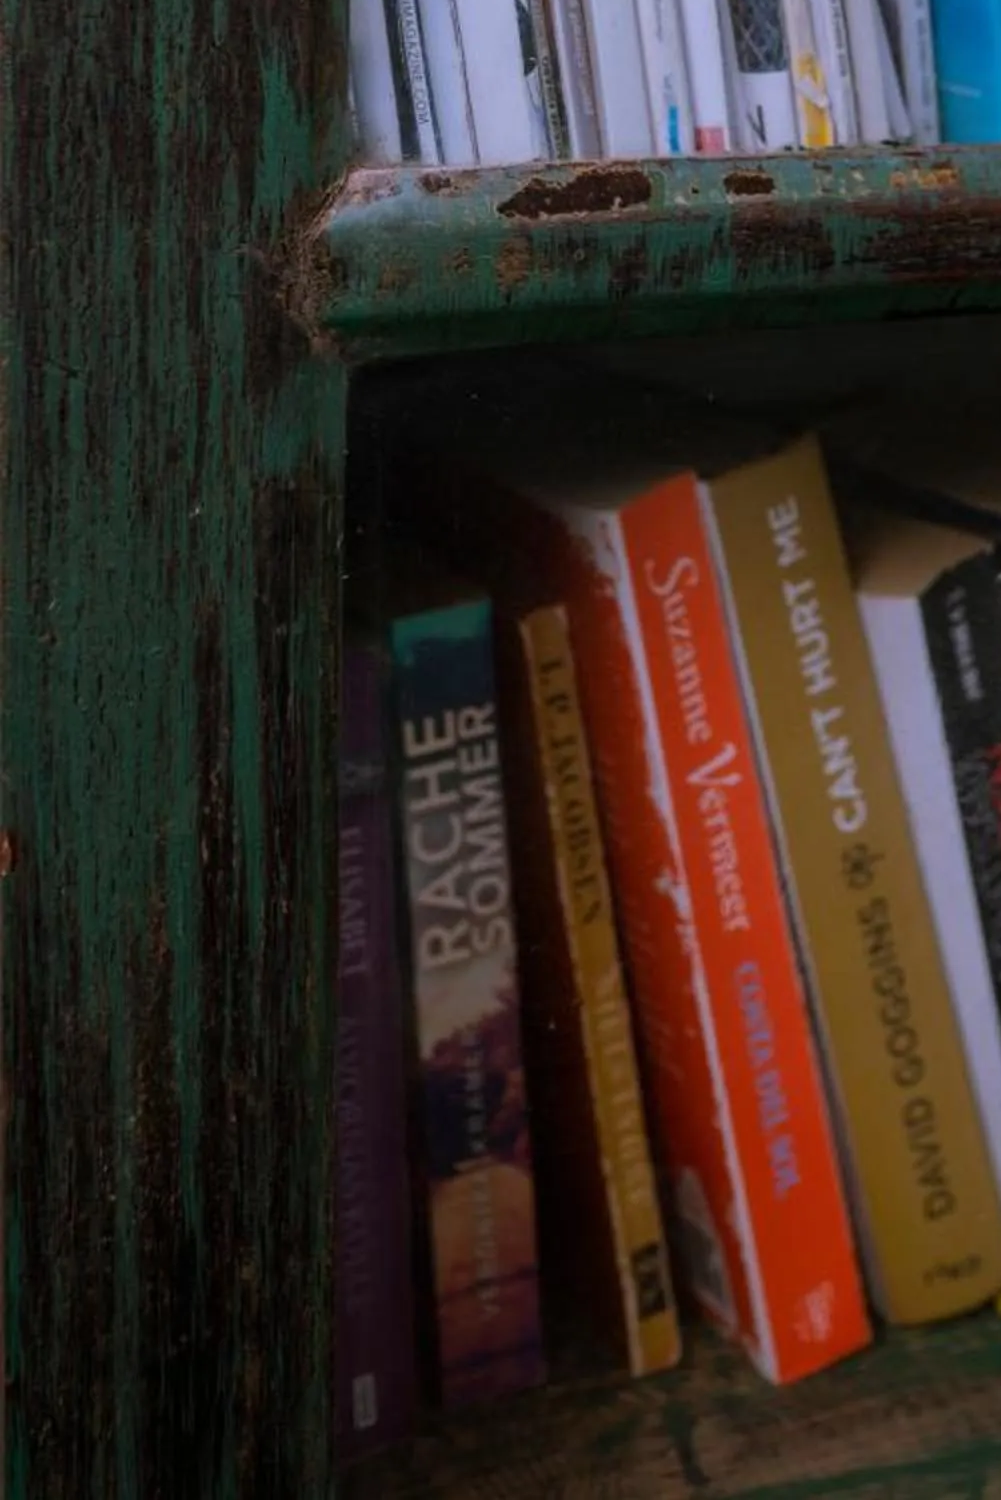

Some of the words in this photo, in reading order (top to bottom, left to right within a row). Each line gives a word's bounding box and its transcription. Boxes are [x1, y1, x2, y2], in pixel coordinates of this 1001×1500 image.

[767, 497, 806, 568] ME
[782, 578, 836, 697] HURT
[644, 556, 713, 746] Suzanne
[686, 742, 751, 931] Vermeer
[809, 704, 867, 833] CAN'T
[404, 709, 471, 969] RACHE
[458, 702, 511, 954] SOMMER
[859, 896, 925, 1088] GOGGINS
[905, 1097, 956, 1222] DAVID
